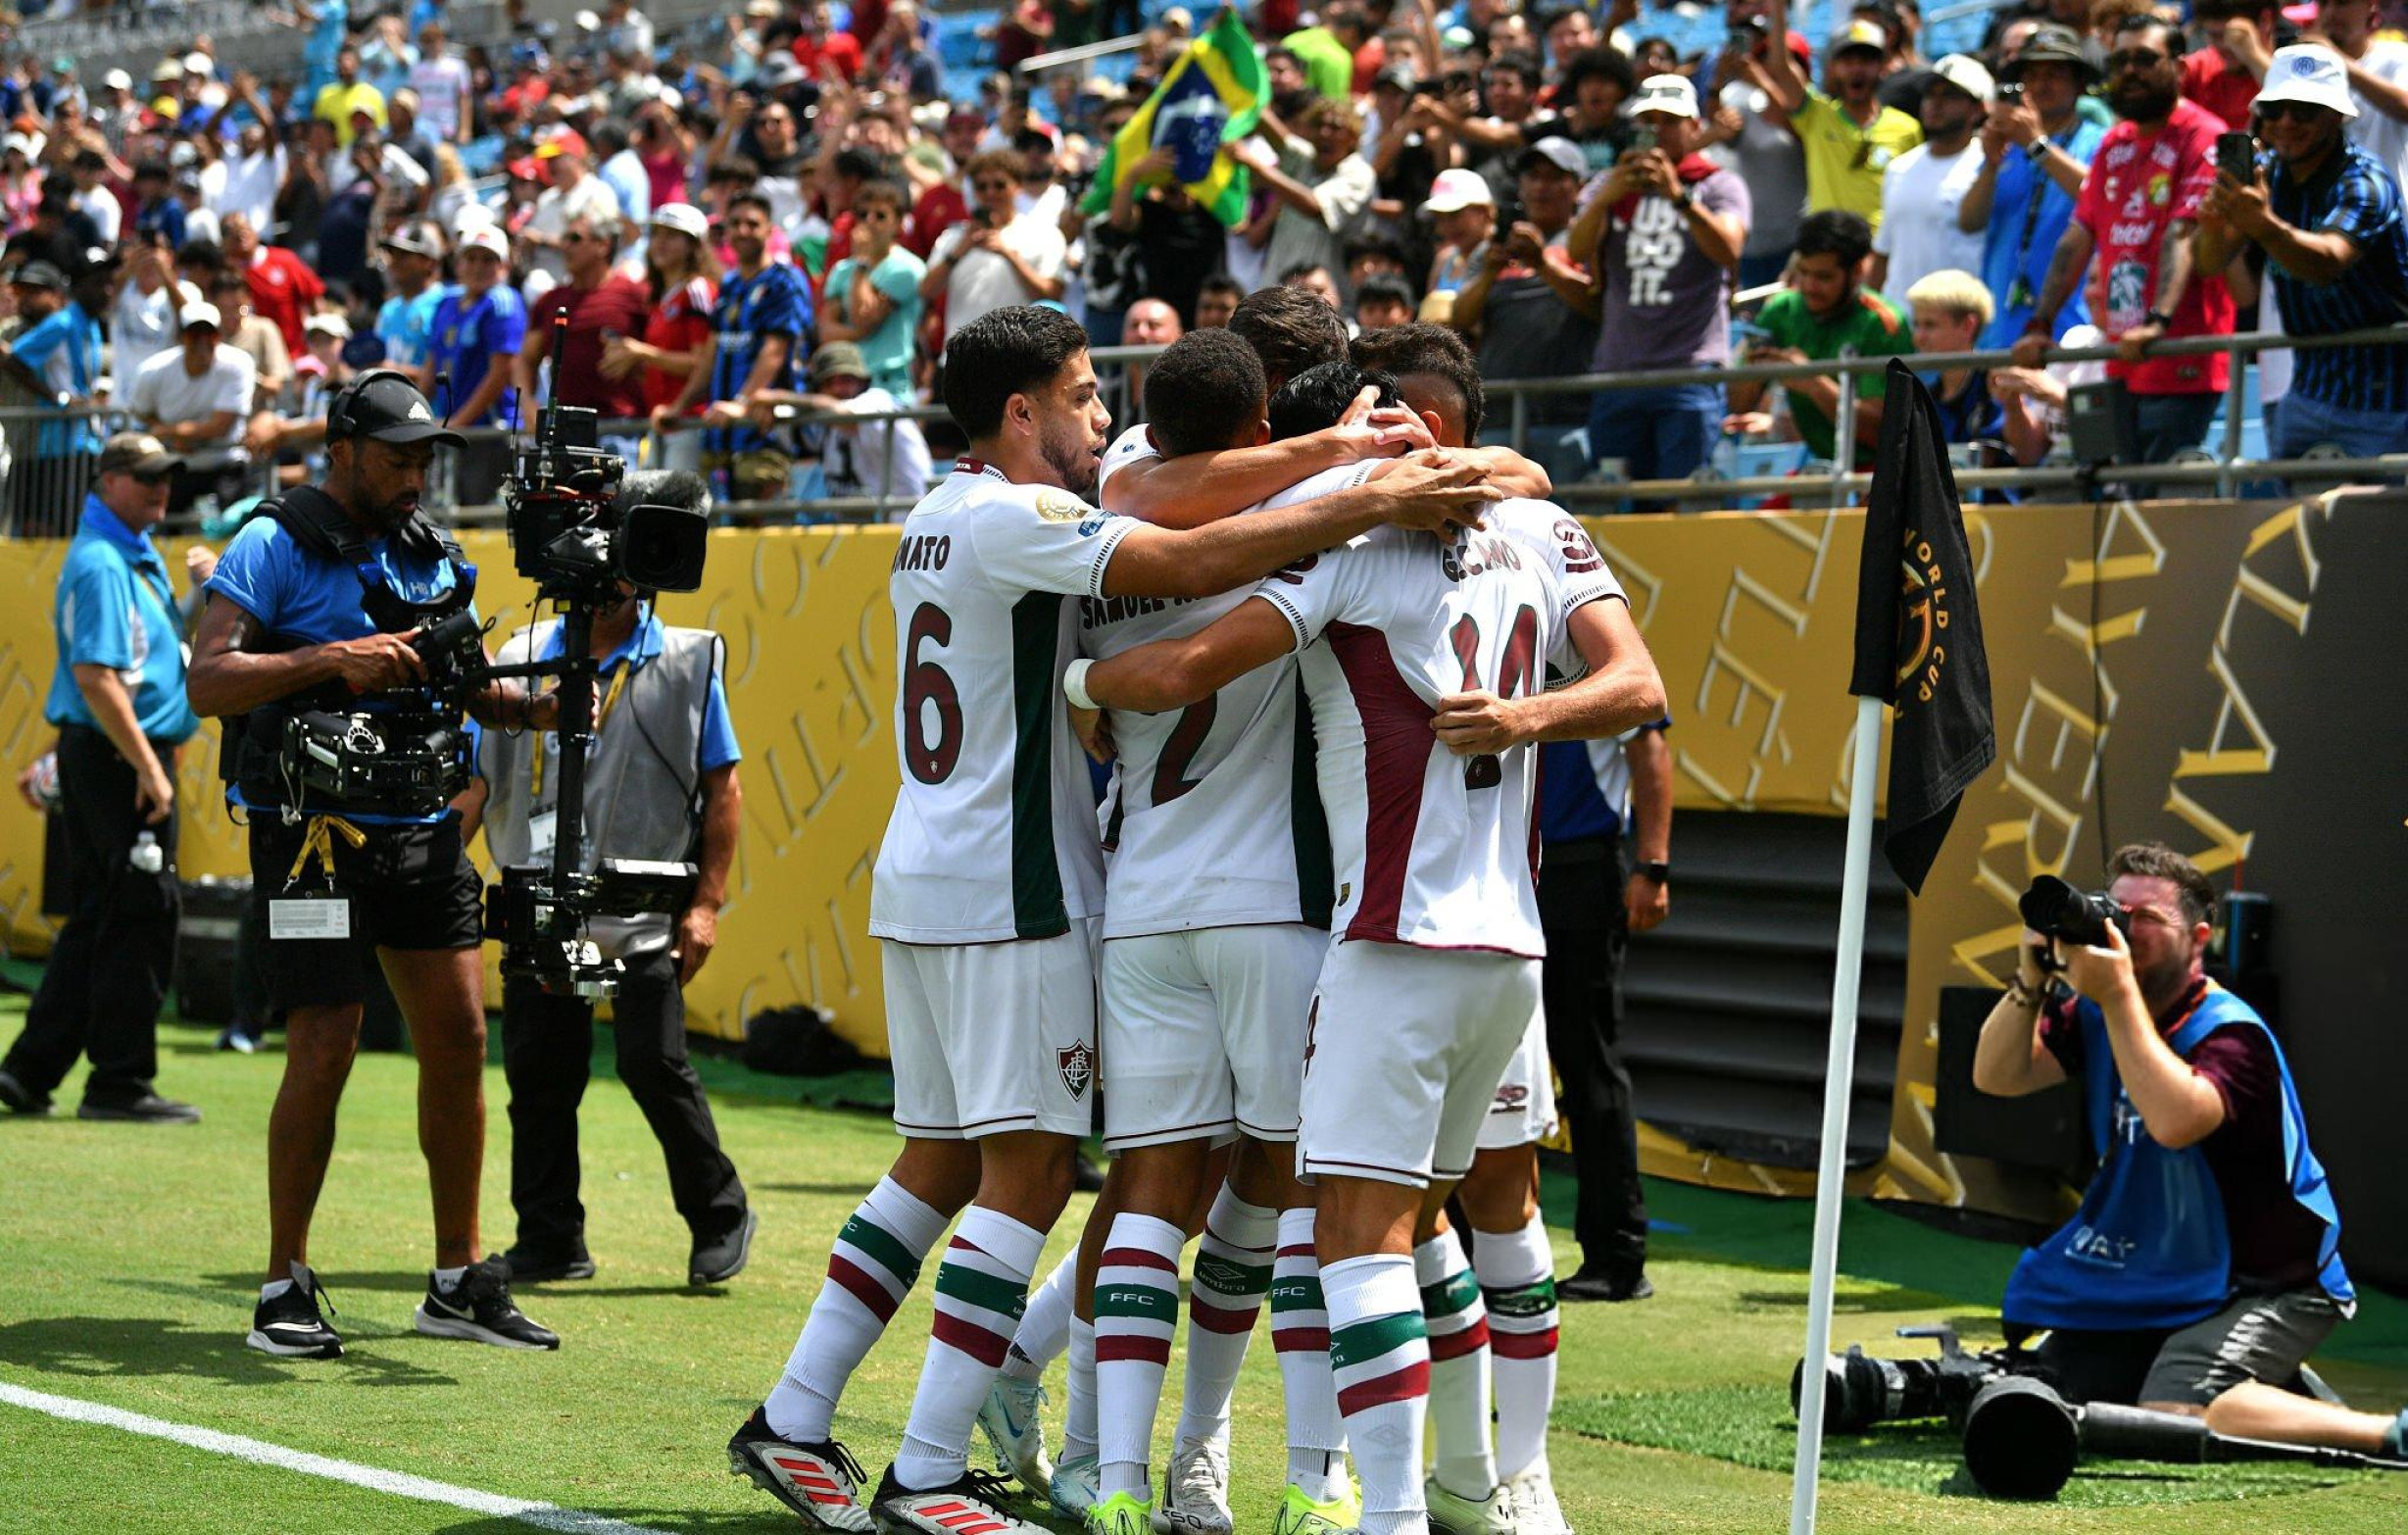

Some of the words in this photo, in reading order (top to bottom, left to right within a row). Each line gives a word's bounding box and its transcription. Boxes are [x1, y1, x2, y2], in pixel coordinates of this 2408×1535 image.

[1625, 231, 1685, 269] DO
[891, 535, 951, 575] NATO
[903, 601, 963, 785] 6
[1918, 645, 1944, 702] CUP
[1109, 1292, 1155, 1306] FFC
